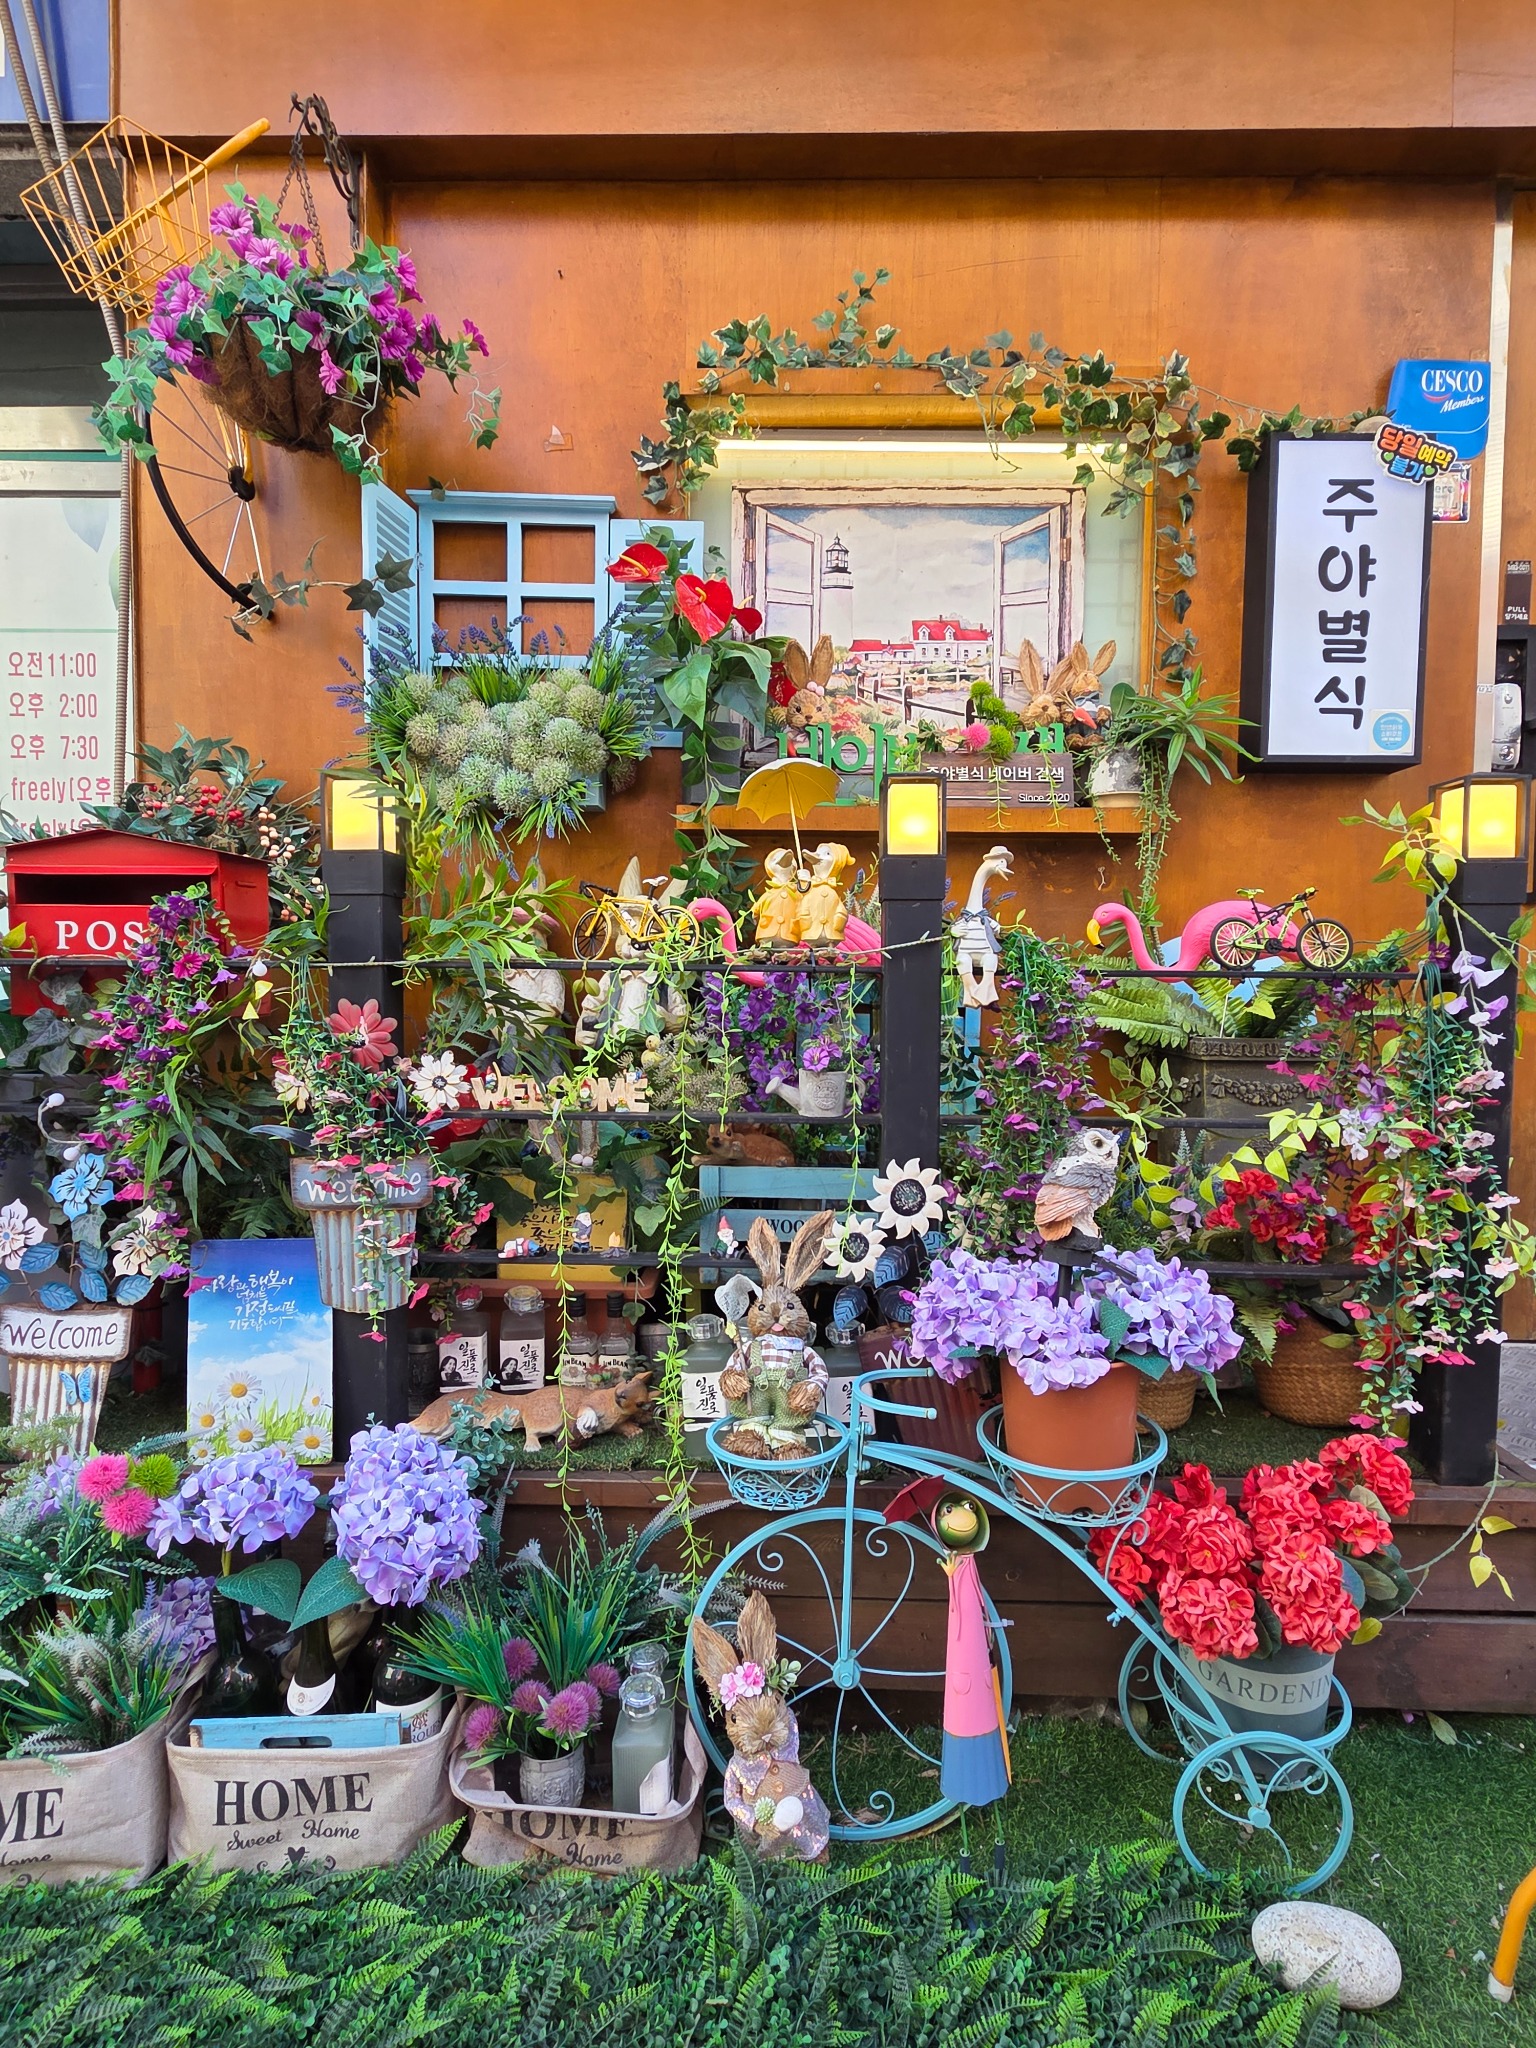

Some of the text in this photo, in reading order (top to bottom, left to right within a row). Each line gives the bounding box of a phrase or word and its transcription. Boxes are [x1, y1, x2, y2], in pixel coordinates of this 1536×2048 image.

[1421, 369, 1483, 393] CESCO
[1440, 394, 1485, 414] Members
[1391, 455, 1424, 480] 불가
[1314, 479, 1378, 730] 주야별식
[9, 692, 98, 718] 오후 2:00
[10, 734, 99, 760] 오후 7:30
[1018, 794, 1044, 802] Since
[55, 921, 144, 951] POS
[213, 1772, 374, 1827] HOME
[227, 1819, 360, 1851] Sweet Home
[567, 1842, 623, 1866] Home
